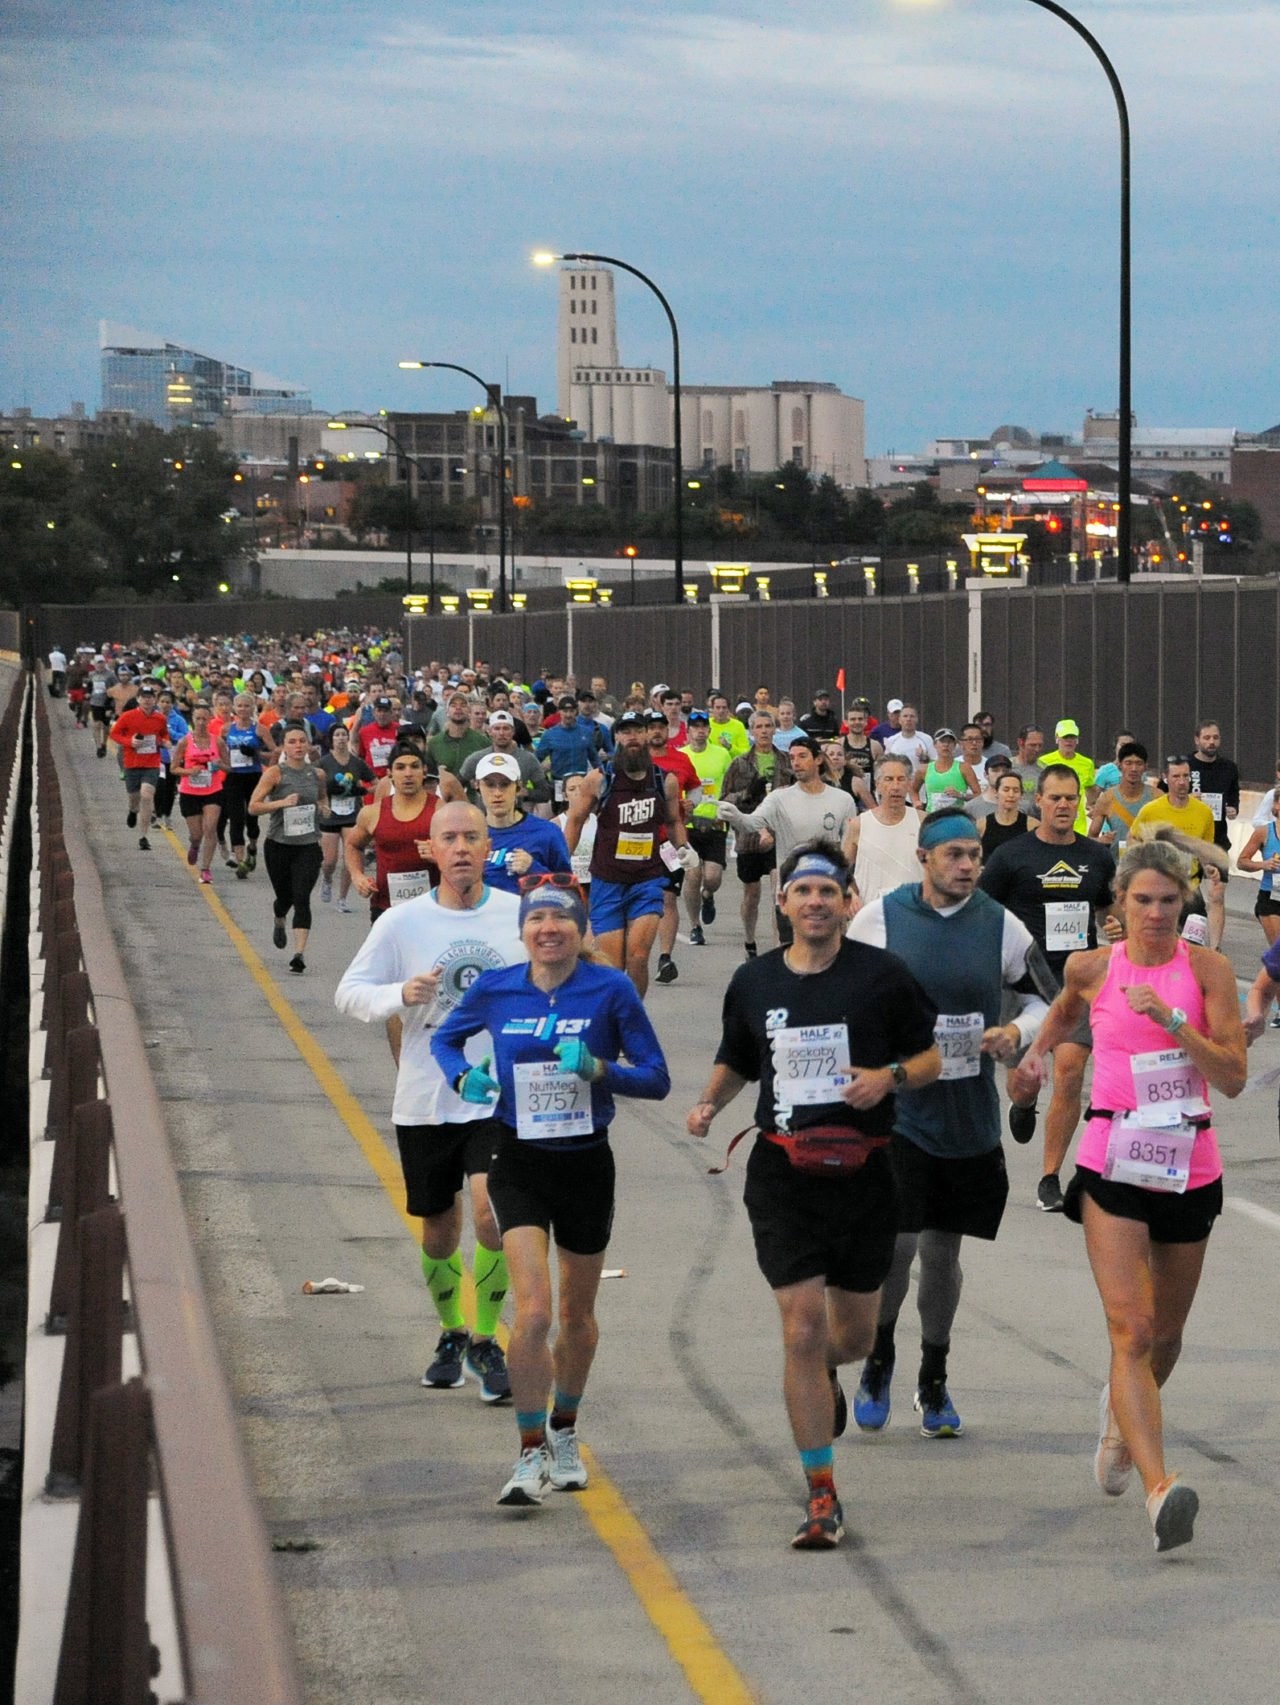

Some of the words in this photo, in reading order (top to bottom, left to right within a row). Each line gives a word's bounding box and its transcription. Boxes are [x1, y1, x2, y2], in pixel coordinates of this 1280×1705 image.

[396, 886, 424, 899] 4042
[1053, 922, 1081, 934] 4461
[946, 1016, 971, 1025] HALF
[800, 1028, 830, 1039] HALF
[788, 1056, 838, 1079] 3772
[529, 1081, 577, 1093] NutMeg
[1148, 1078, 1194, 1103] 8351
[528, 1092, 579, 1112] 3757
[1129, 1140, 1178, 1166] 8351
